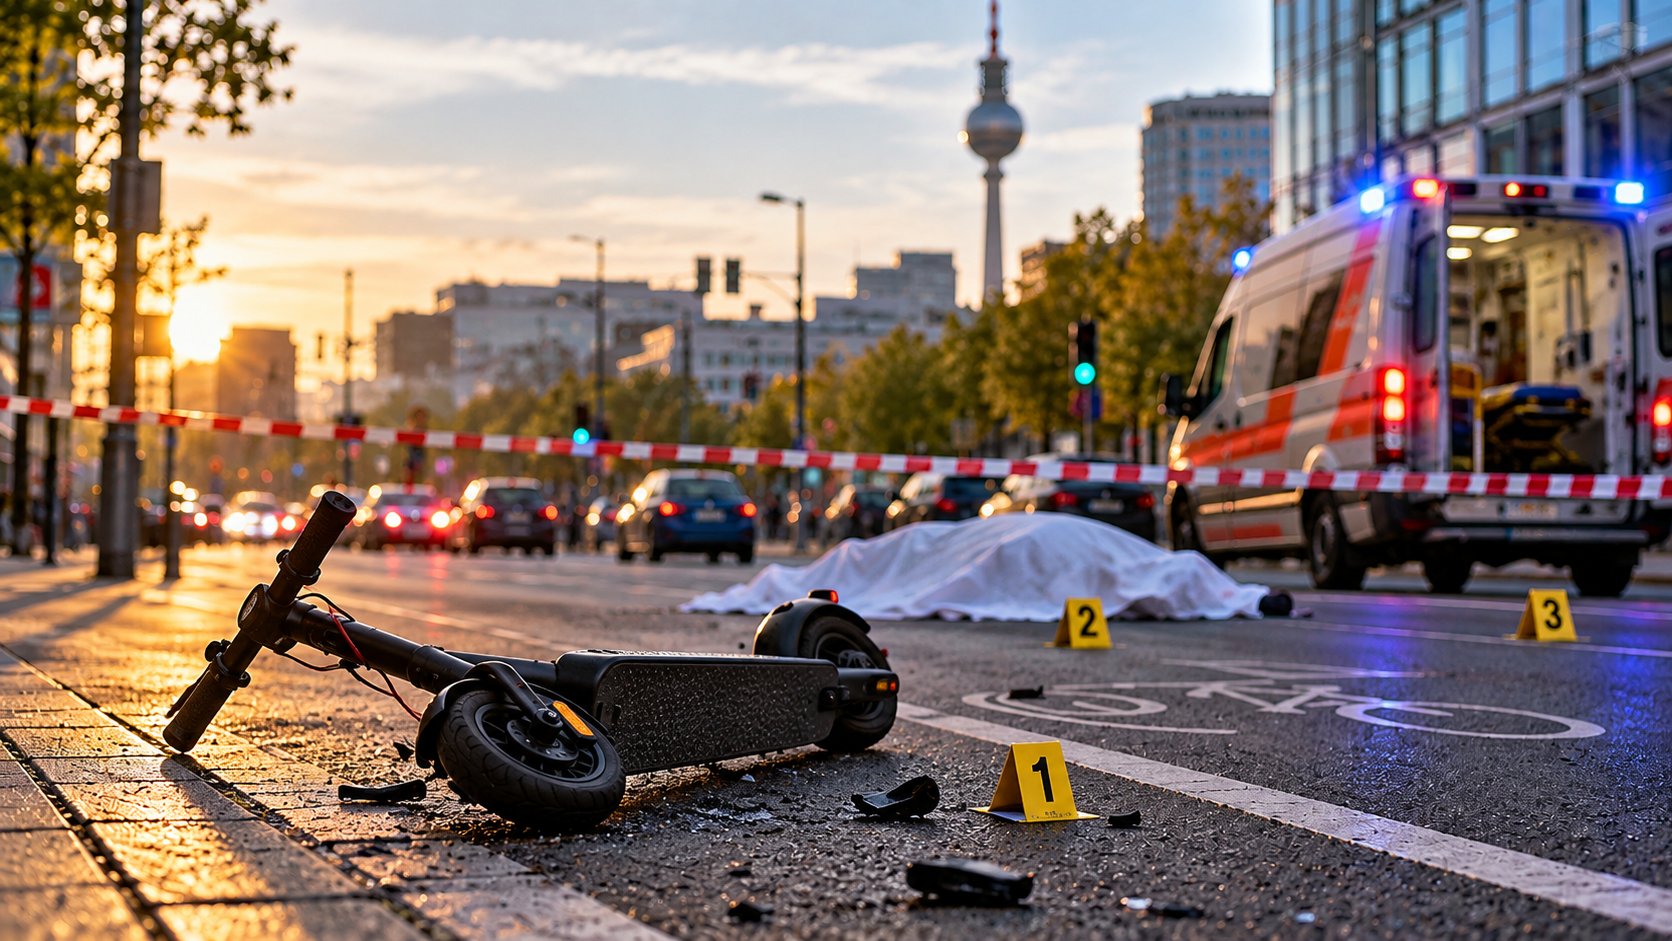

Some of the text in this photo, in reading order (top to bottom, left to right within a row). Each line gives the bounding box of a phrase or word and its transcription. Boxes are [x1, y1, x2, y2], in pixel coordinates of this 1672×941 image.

[1078, 605, 1098, 637] 2
[1543, 598, 1562, 631] 3
[1031, 756, 1055, 803] 1
